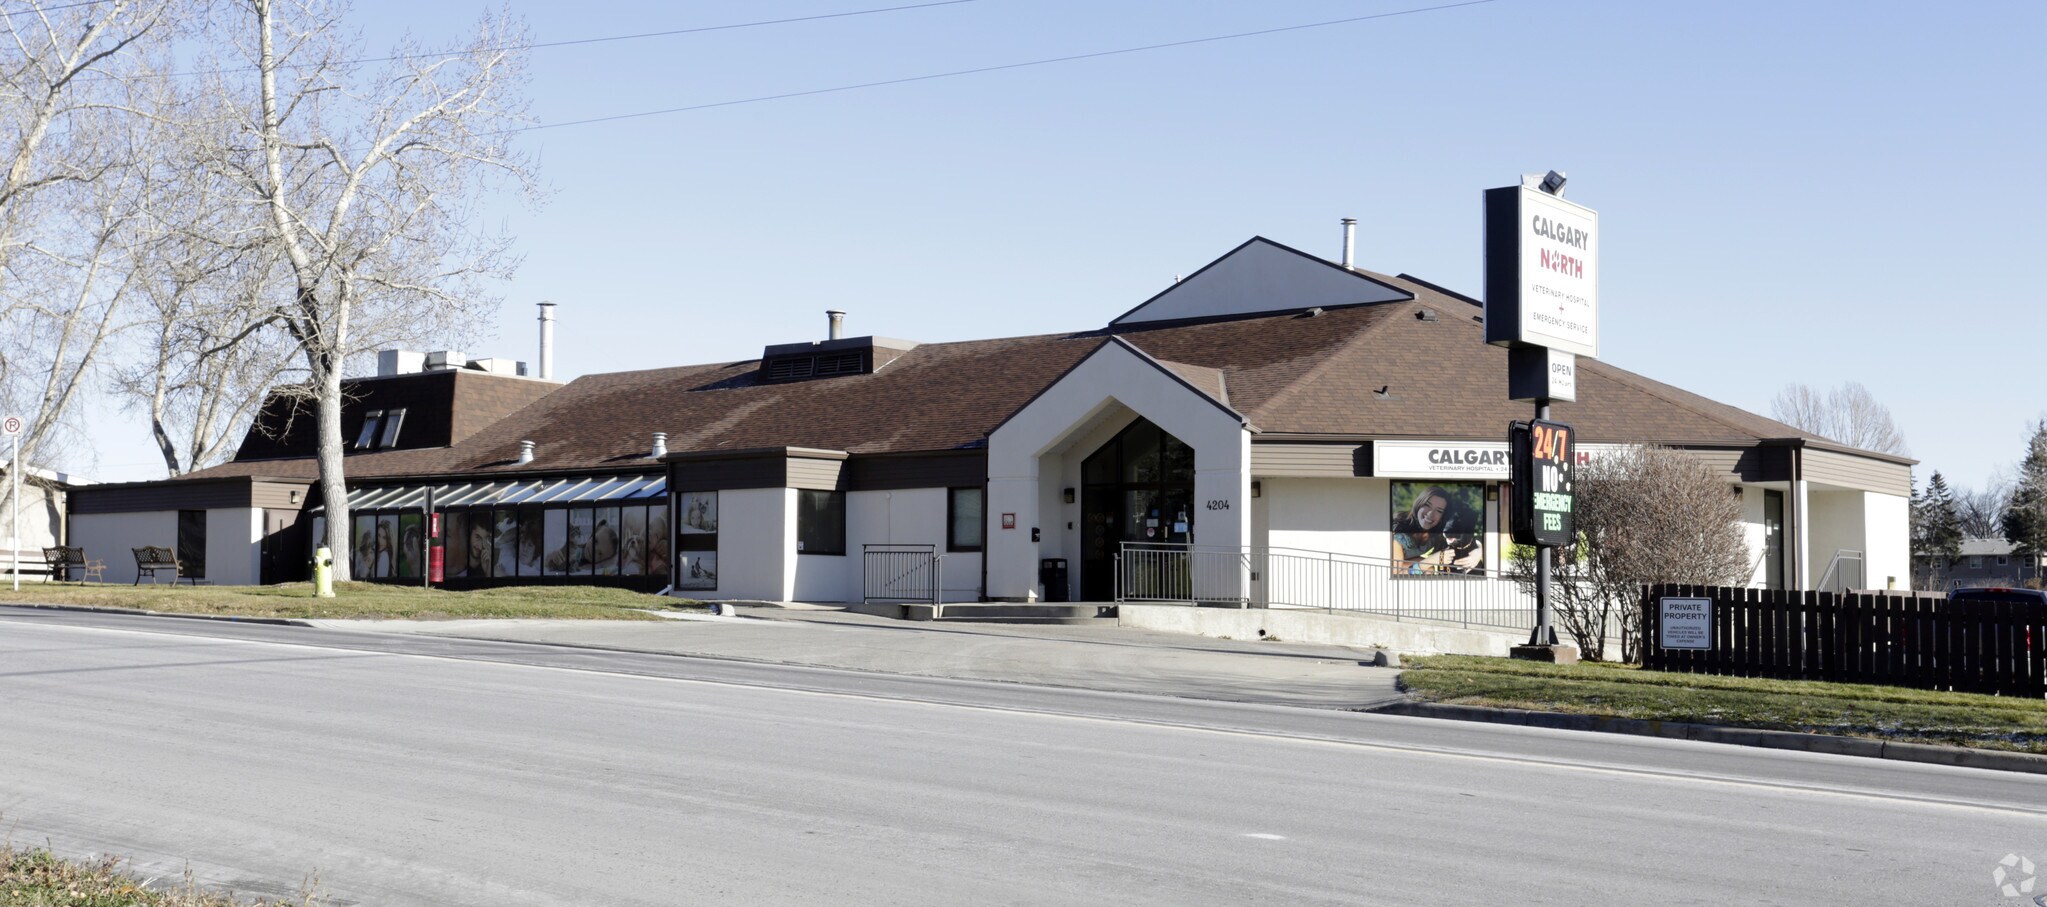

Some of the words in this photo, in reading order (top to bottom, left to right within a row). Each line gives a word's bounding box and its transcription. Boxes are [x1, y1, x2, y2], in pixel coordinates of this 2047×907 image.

[1532, 214, 1588, 251] CALGARY
[1531, 283, 1565, 300] VETERINARY
[1566, 293, 1590, 308] HOSPITAL
[1533, 312, 1565, 327] EMERGENCY
[1567, 321, 1588, 334] SERVICE
[1551, 362, 1572, 377] OPEN
[1534, 425, 1567, 461] 24/7
[1542, 465, 1559, 493] NO
[1206, 499, 1230, 511] 4204
[1533, 492, 1572, 513] EMERGENCY
[1543, 513, 1562, 531] FEES
[1664, 612, 1707, 620] PROPERTY
